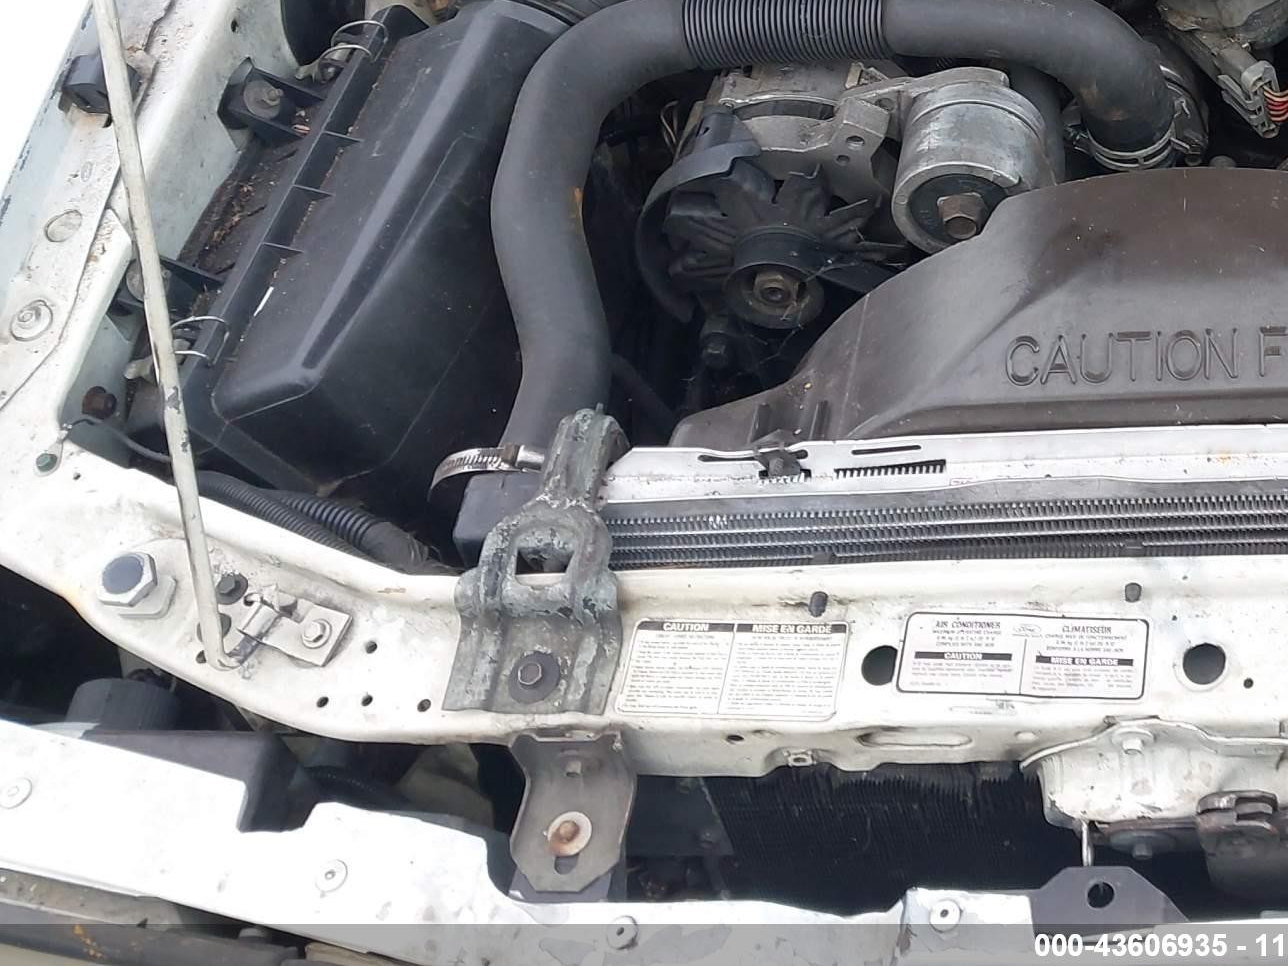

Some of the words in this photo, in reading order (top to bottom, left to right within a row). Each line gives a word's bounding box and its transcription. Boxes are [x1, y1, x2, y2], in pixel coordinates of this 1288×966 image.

[1004, 327, 1240, 387] CAUTION
[663, 622, 709, 632] CAUTION
[752, 624, 779, 633] MISE
[780, 625, 795, 633] EN
[796, 625, 832, 634] GARDE
[943, 652, 983, 660] CAUTION
[1050, 656, 1073, 665] MISE
[1074, 657, 1087, 665] EN
[1088, 657, 1119, 666] GARDE
